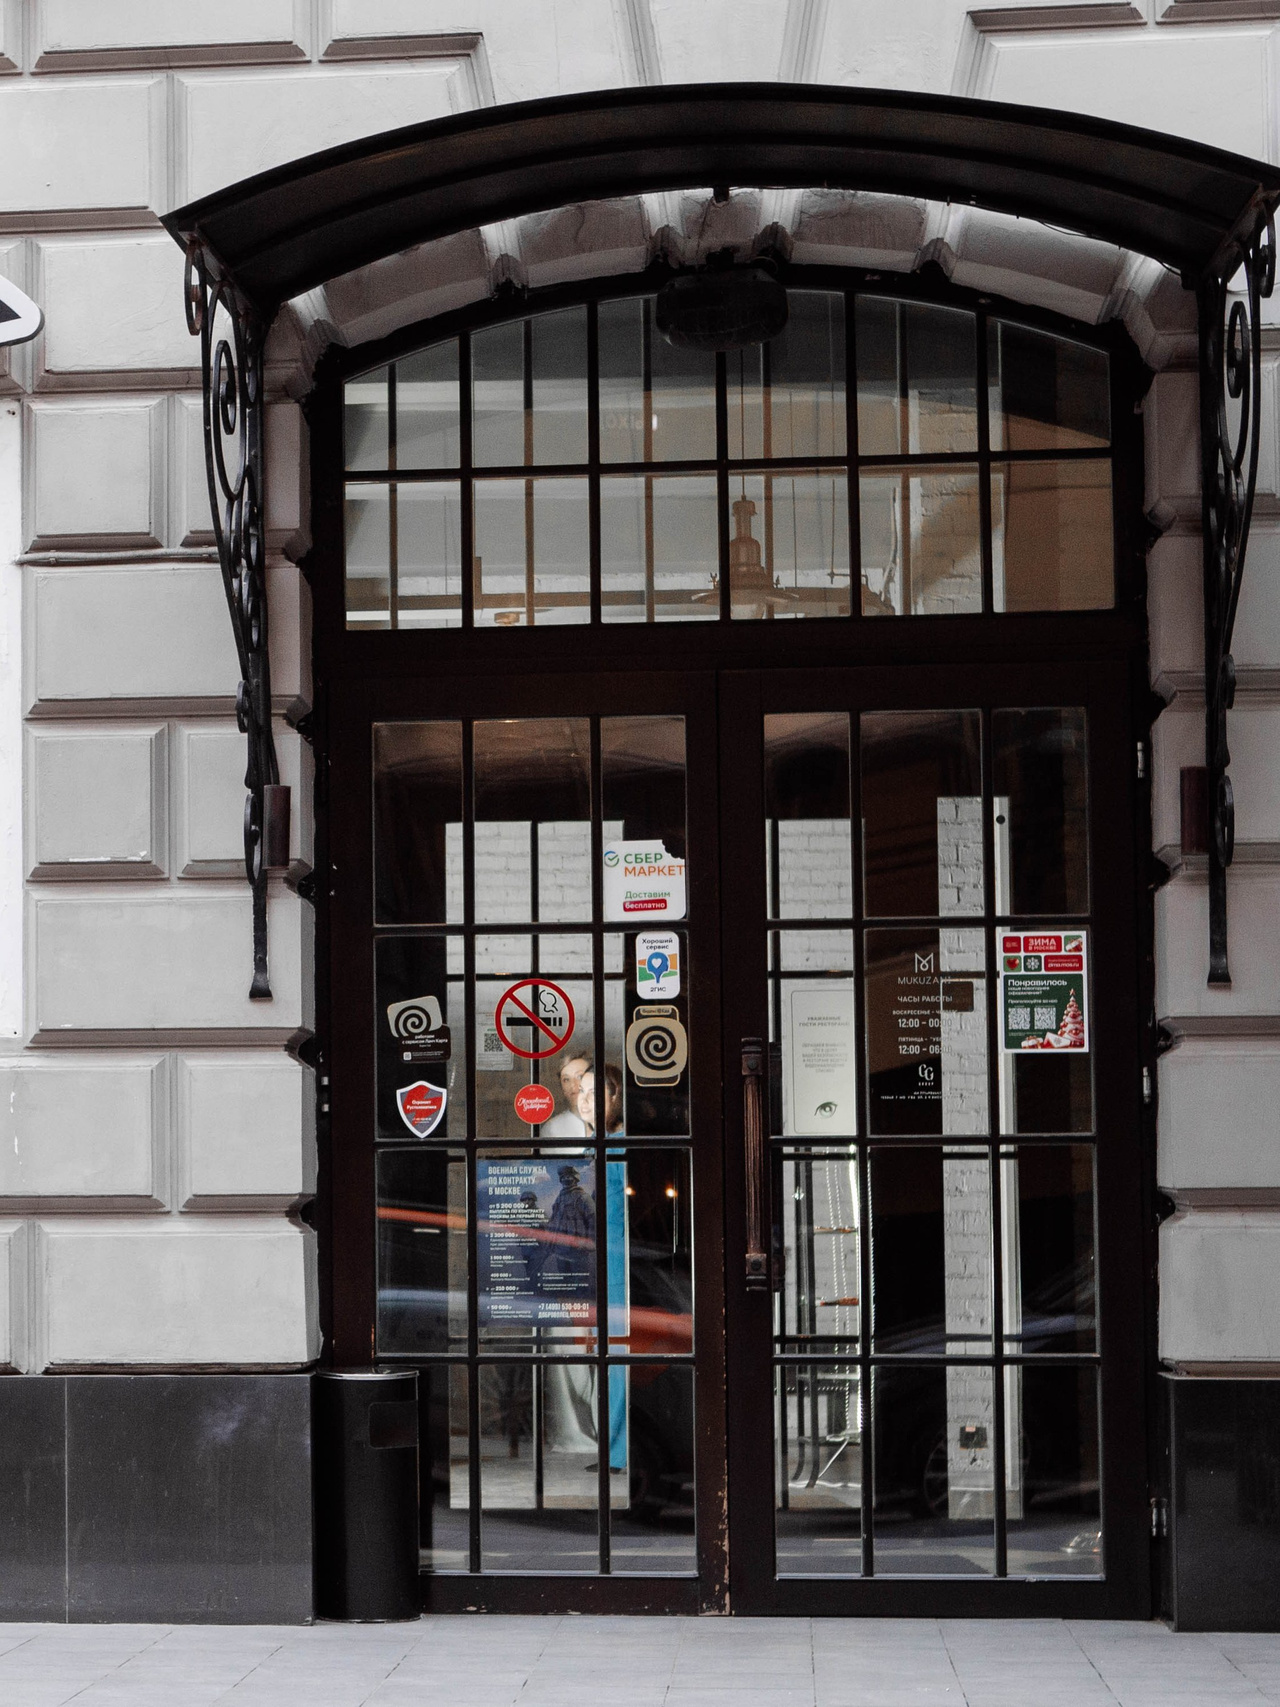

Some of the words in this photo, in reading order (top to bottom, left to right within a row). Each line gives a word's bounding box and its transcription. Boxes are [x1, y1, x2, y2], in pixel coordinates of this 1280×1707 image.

[624, 853, 663, 864] СБЕР
[624, 865, 686, 877] МАРКЕТ
[624, 891, 671, 899] Доставим
[624, 900, 666, 909] бесплатно
[1028, 938, 1057, 946] ЗИМА
[1008, 979, 1068, 987] Понравилось
[897, 995, 920, 1003] ЧАСЫ
[921, 995, 953, 1003] РАБОТЫ
[898, 1019, 920, 1028] 12:00
[899, 1045, 921, 1055] 12:00
[488, 1166, 518, 1175] ВОЕННАЯ
[519, 1165, 547, 1174] СЛУЖБА
[488, 1176, 498, 1185] ПО
[498, 1176, 536, 1185] КОНТРАКТУ
[488, 1187, 494, 1195] В
[494, 1187, 521, 1195] МОСКВЕ
